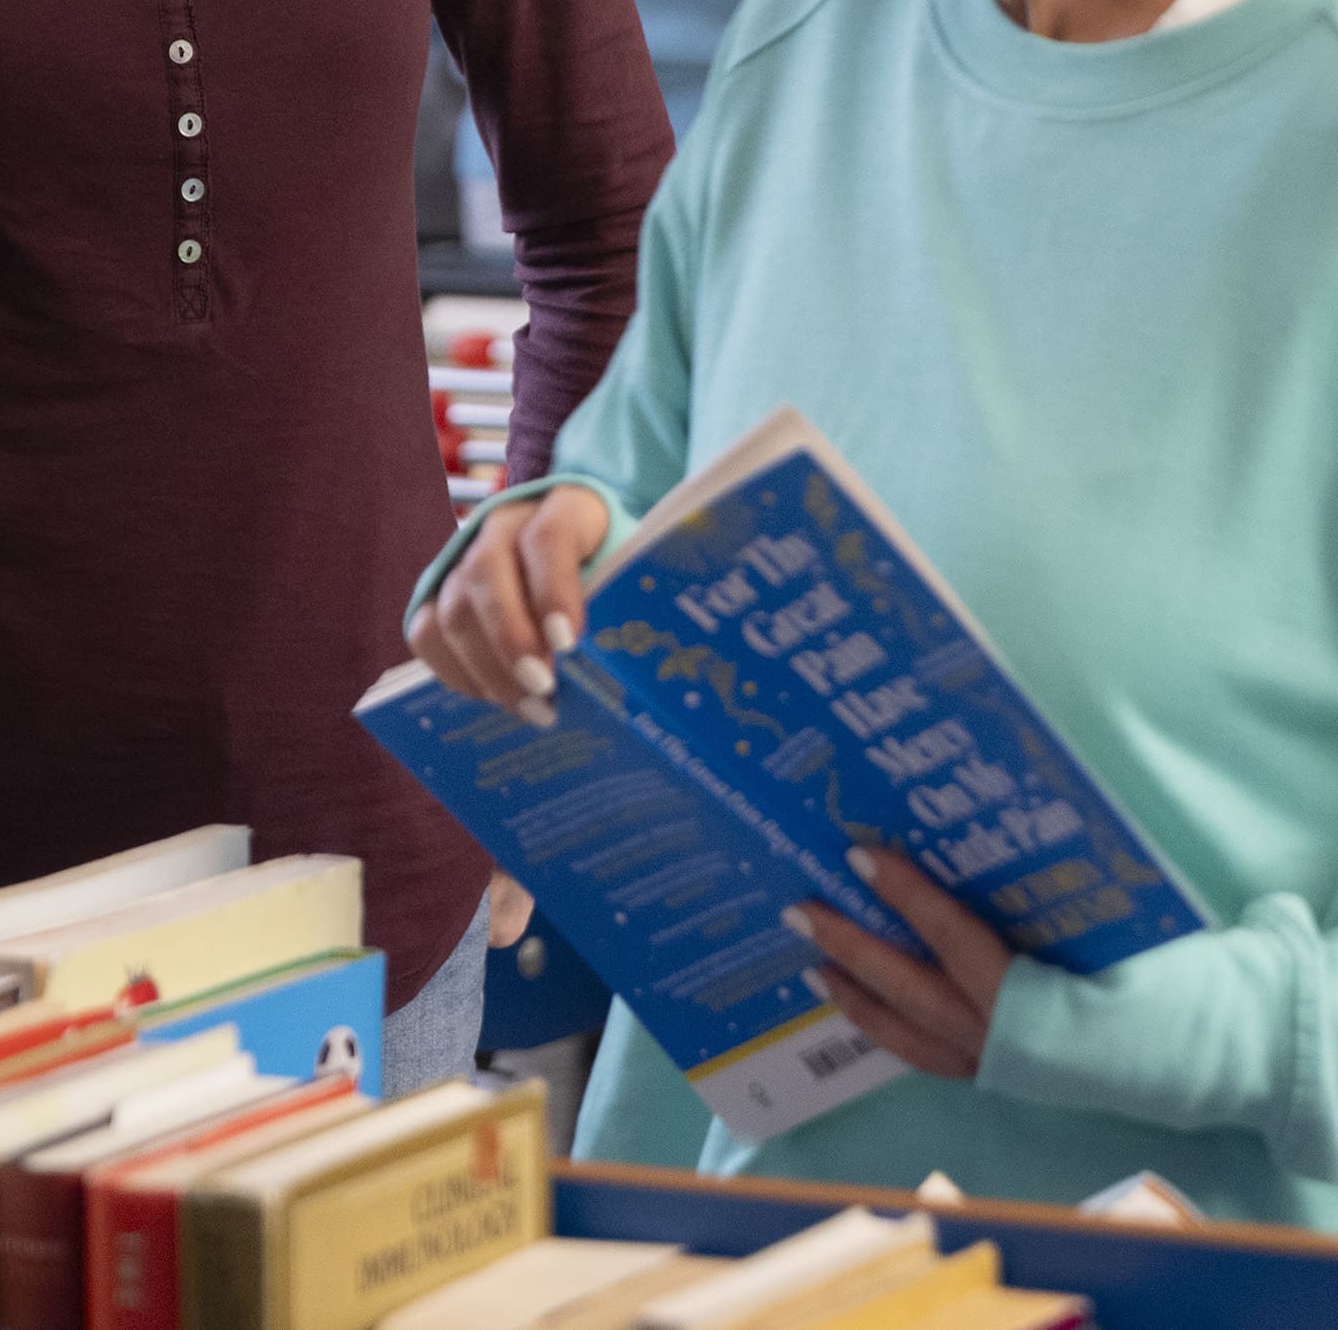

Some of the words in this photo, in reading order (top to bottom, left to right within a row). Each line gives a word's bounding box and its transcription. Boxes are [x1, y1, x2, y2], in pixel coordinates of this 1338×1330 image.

[676, 572, 760, 632] For
[738, 532, 821, 590] Thy
[741, 580, 852, 658] Great
[789, 628, 888, 699] Pain
[829, 670, 933, 740] Have
[865, 715, 977, 789] Mercy
[907, 770, 970, 832] On
[949, 748, 1019, 812] My
[919, 820, 1019, 887] Little
[1002, 793, 1086, 856] Pain
